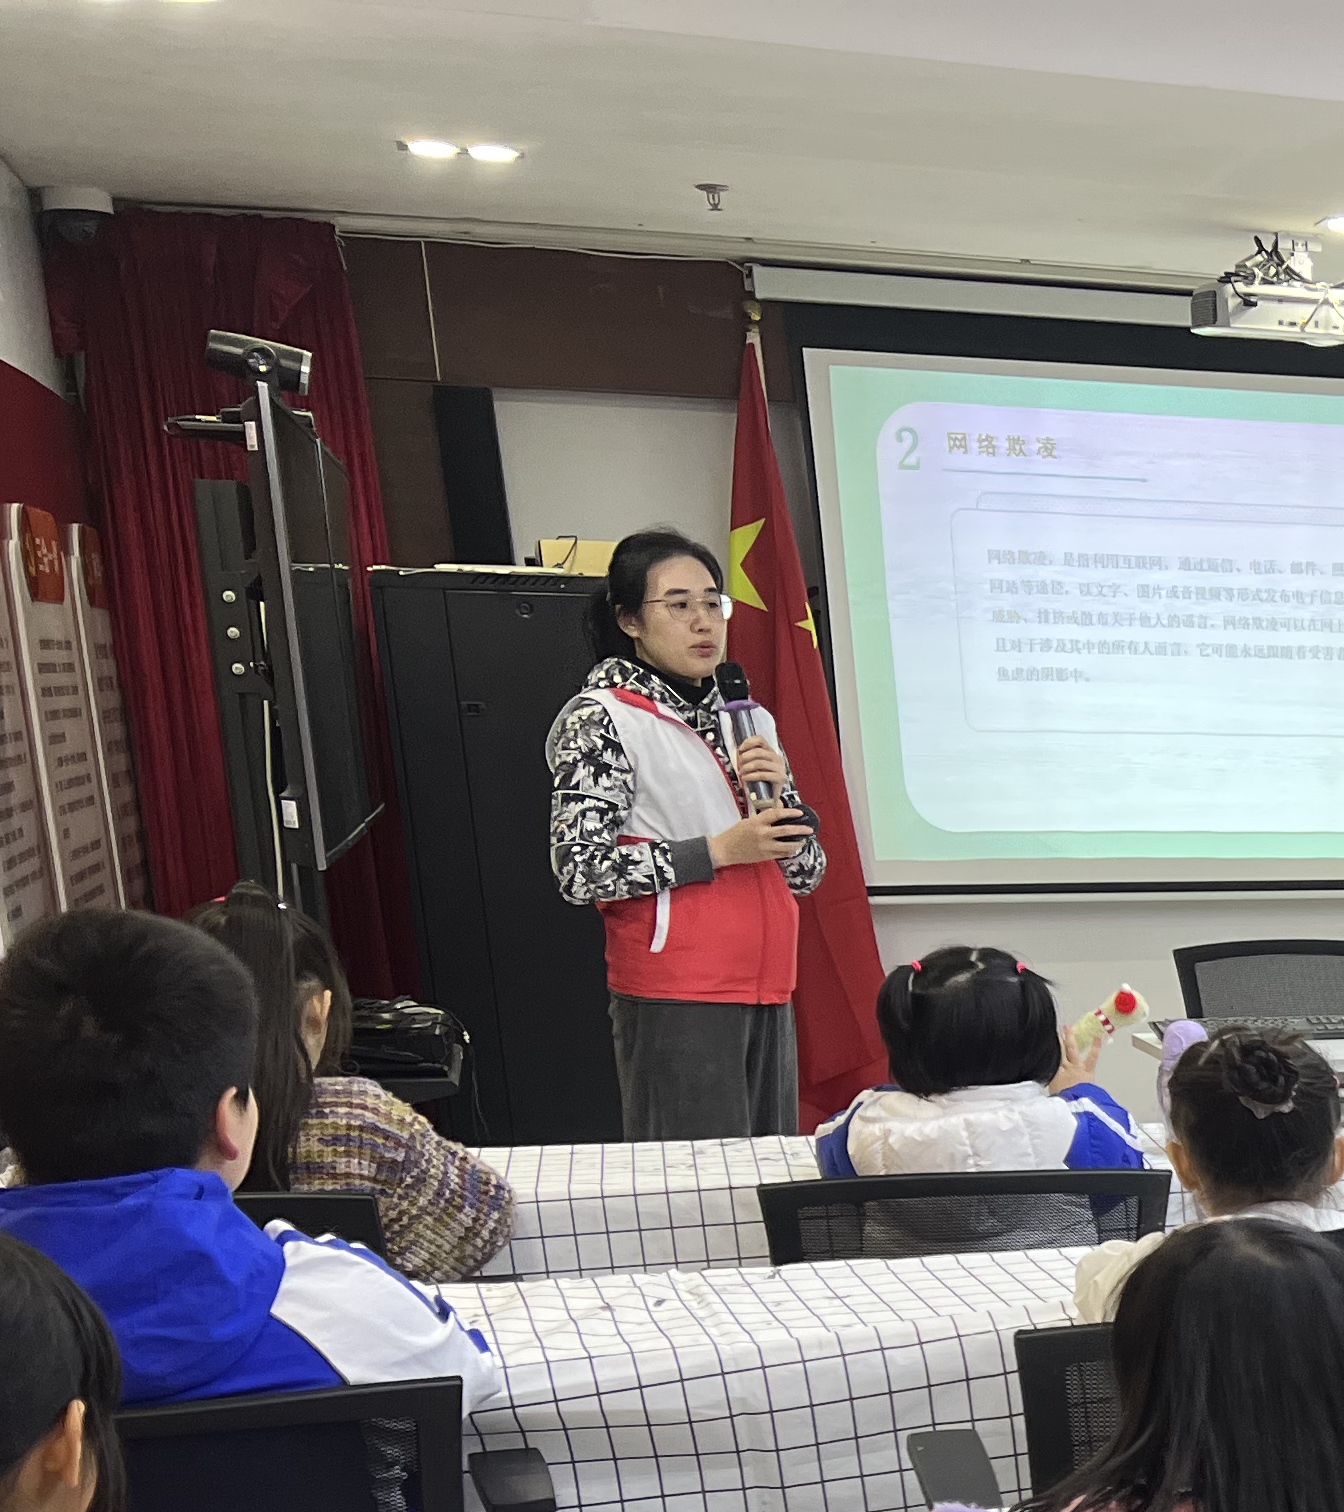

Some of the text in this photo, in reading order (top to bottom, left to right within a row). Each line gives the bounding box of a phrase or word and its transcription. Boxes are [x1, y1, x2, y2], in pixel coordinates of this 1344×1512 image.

[895, 426, 921, 471] 2
[946, 431, 1058, 460] 网络欺凌
